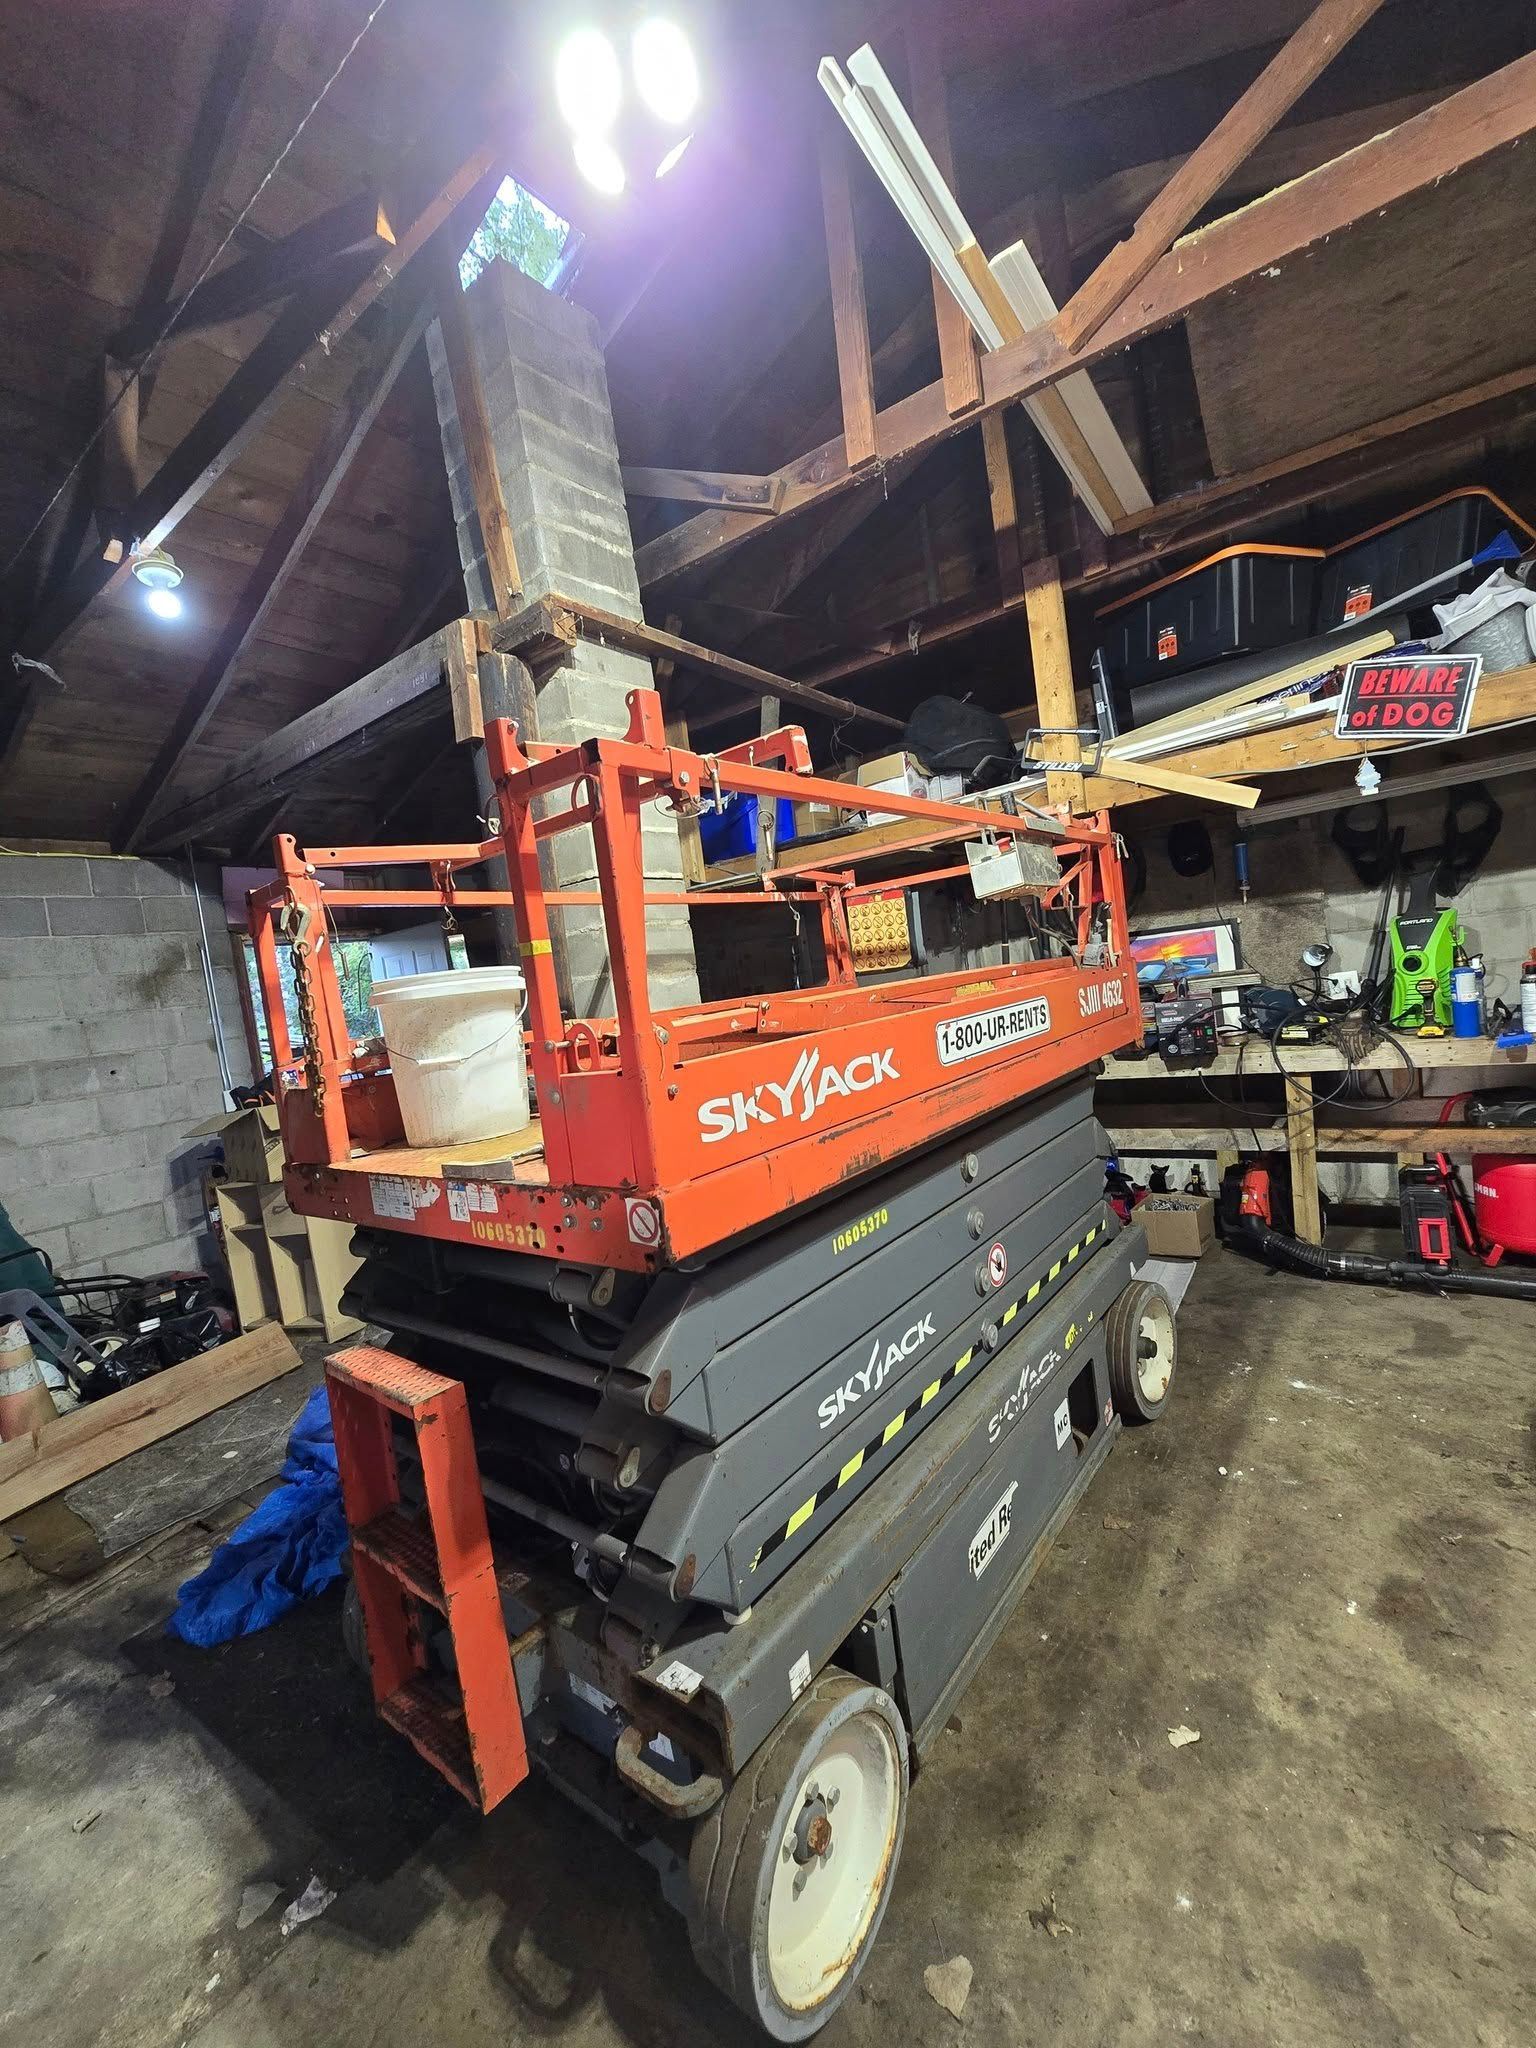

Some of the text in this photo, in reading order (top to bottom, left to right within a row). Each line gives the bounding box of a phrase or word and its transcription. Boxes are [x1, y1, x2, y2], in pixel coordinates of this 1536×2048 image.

[1358, 667, 1463, 694] BEWARE
[1351, 701, 1453, 727] of DOG
[1033, 761, 1083, 772] STILLEN
[1399, 918, 1434, 926] PORTLAND
[1102, 979, 1124, 1008] 4632
[942, 1004, 1047, 1056] 1-800-UR-RENTS
[697, 1047, 901, 1143] SKYJACK
[831, 1208, 890, 1254] 10605370
[817, 1312, 938, 1430] SKYJACK
